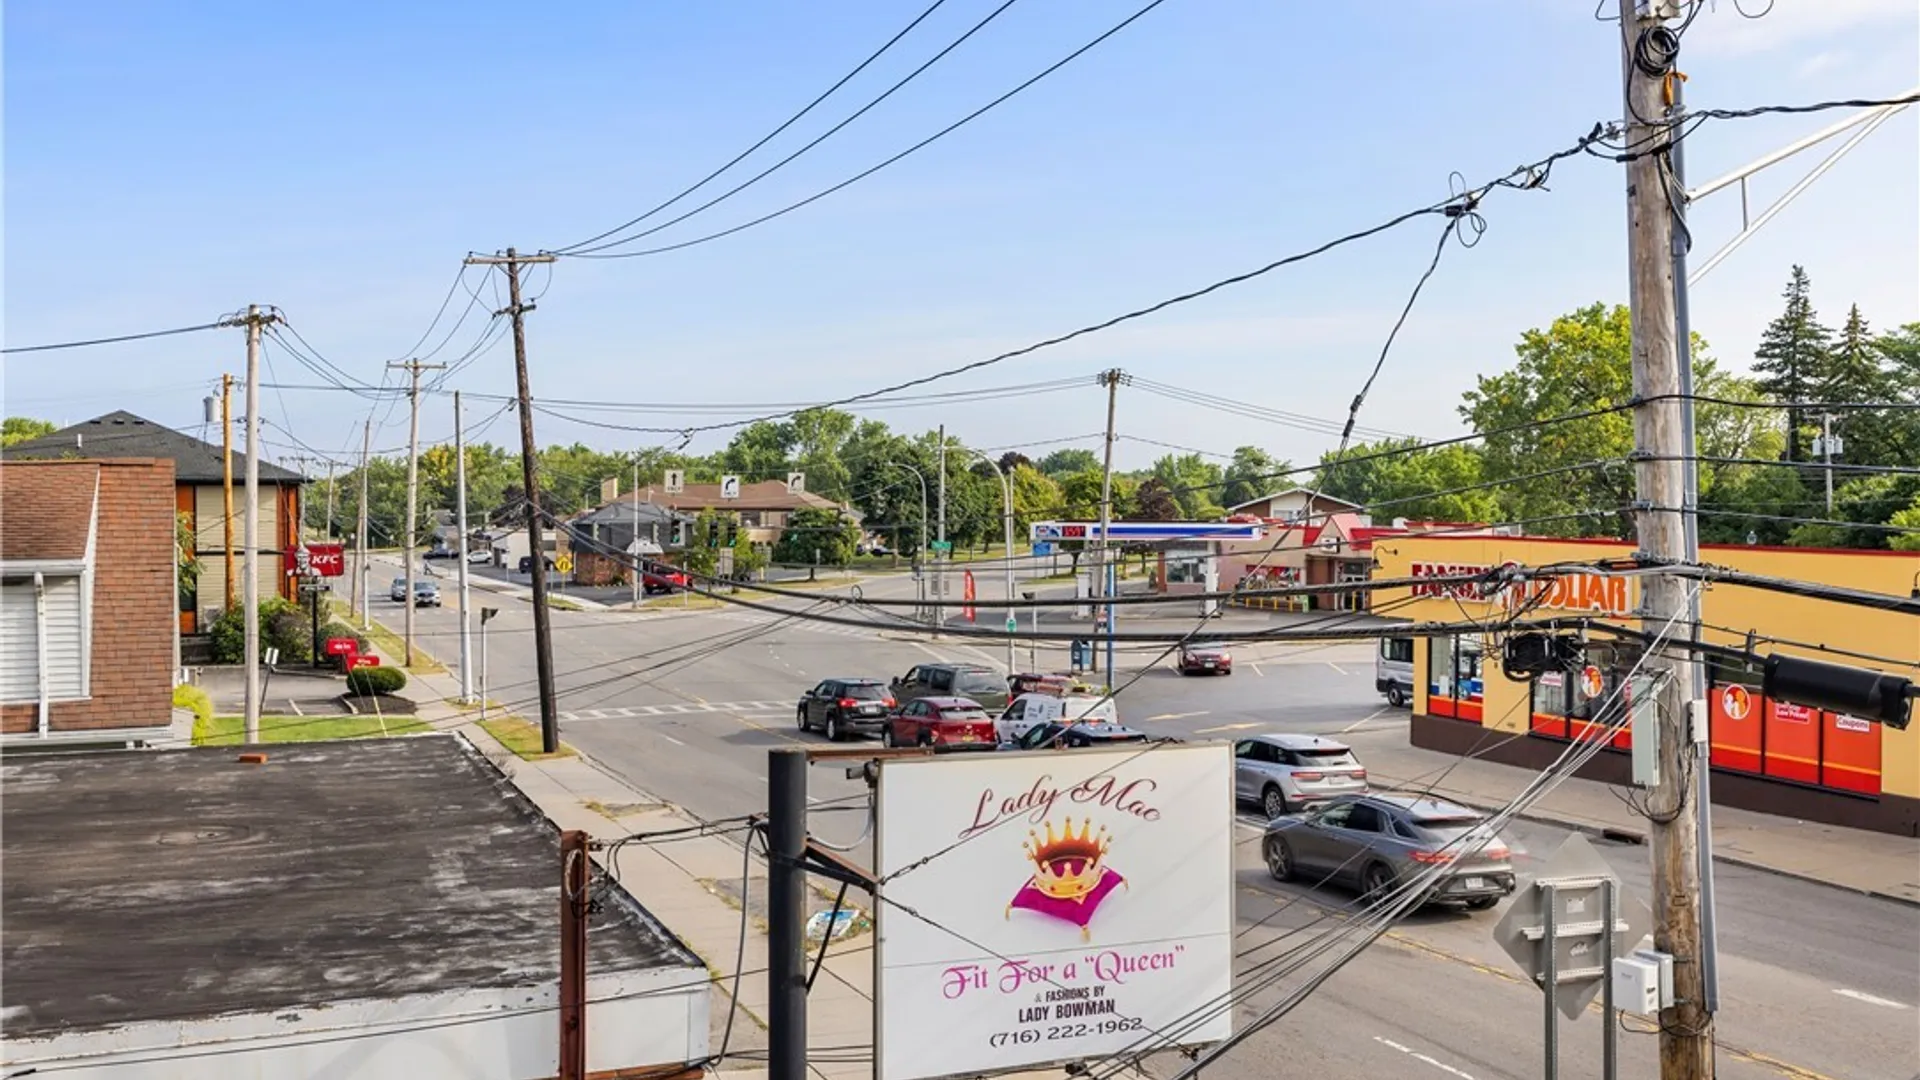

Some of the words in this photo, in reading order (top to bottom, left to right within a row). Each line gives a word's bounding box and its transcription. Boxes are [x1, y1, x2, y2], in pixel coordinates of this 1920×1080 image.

[311, 554, 340, 564] KFC
[957, 775, 1060, 840] Lady
[941, 965, 989, 1000] Fit
[998, 959, 1056, 994] For
[1063, 963, 1077, 980] a
[1045, 986, 1091, 1003] FASHIONS
[1093, 985, 1106, 998] BY
[1018, 1006, 1051, 1025] LADY
[1055, 998, 1116, 1021] BOWMAN
[989, 1028, 1042, 1048] (716)
[1047, 1017, 1144, 1041] 222-1962
